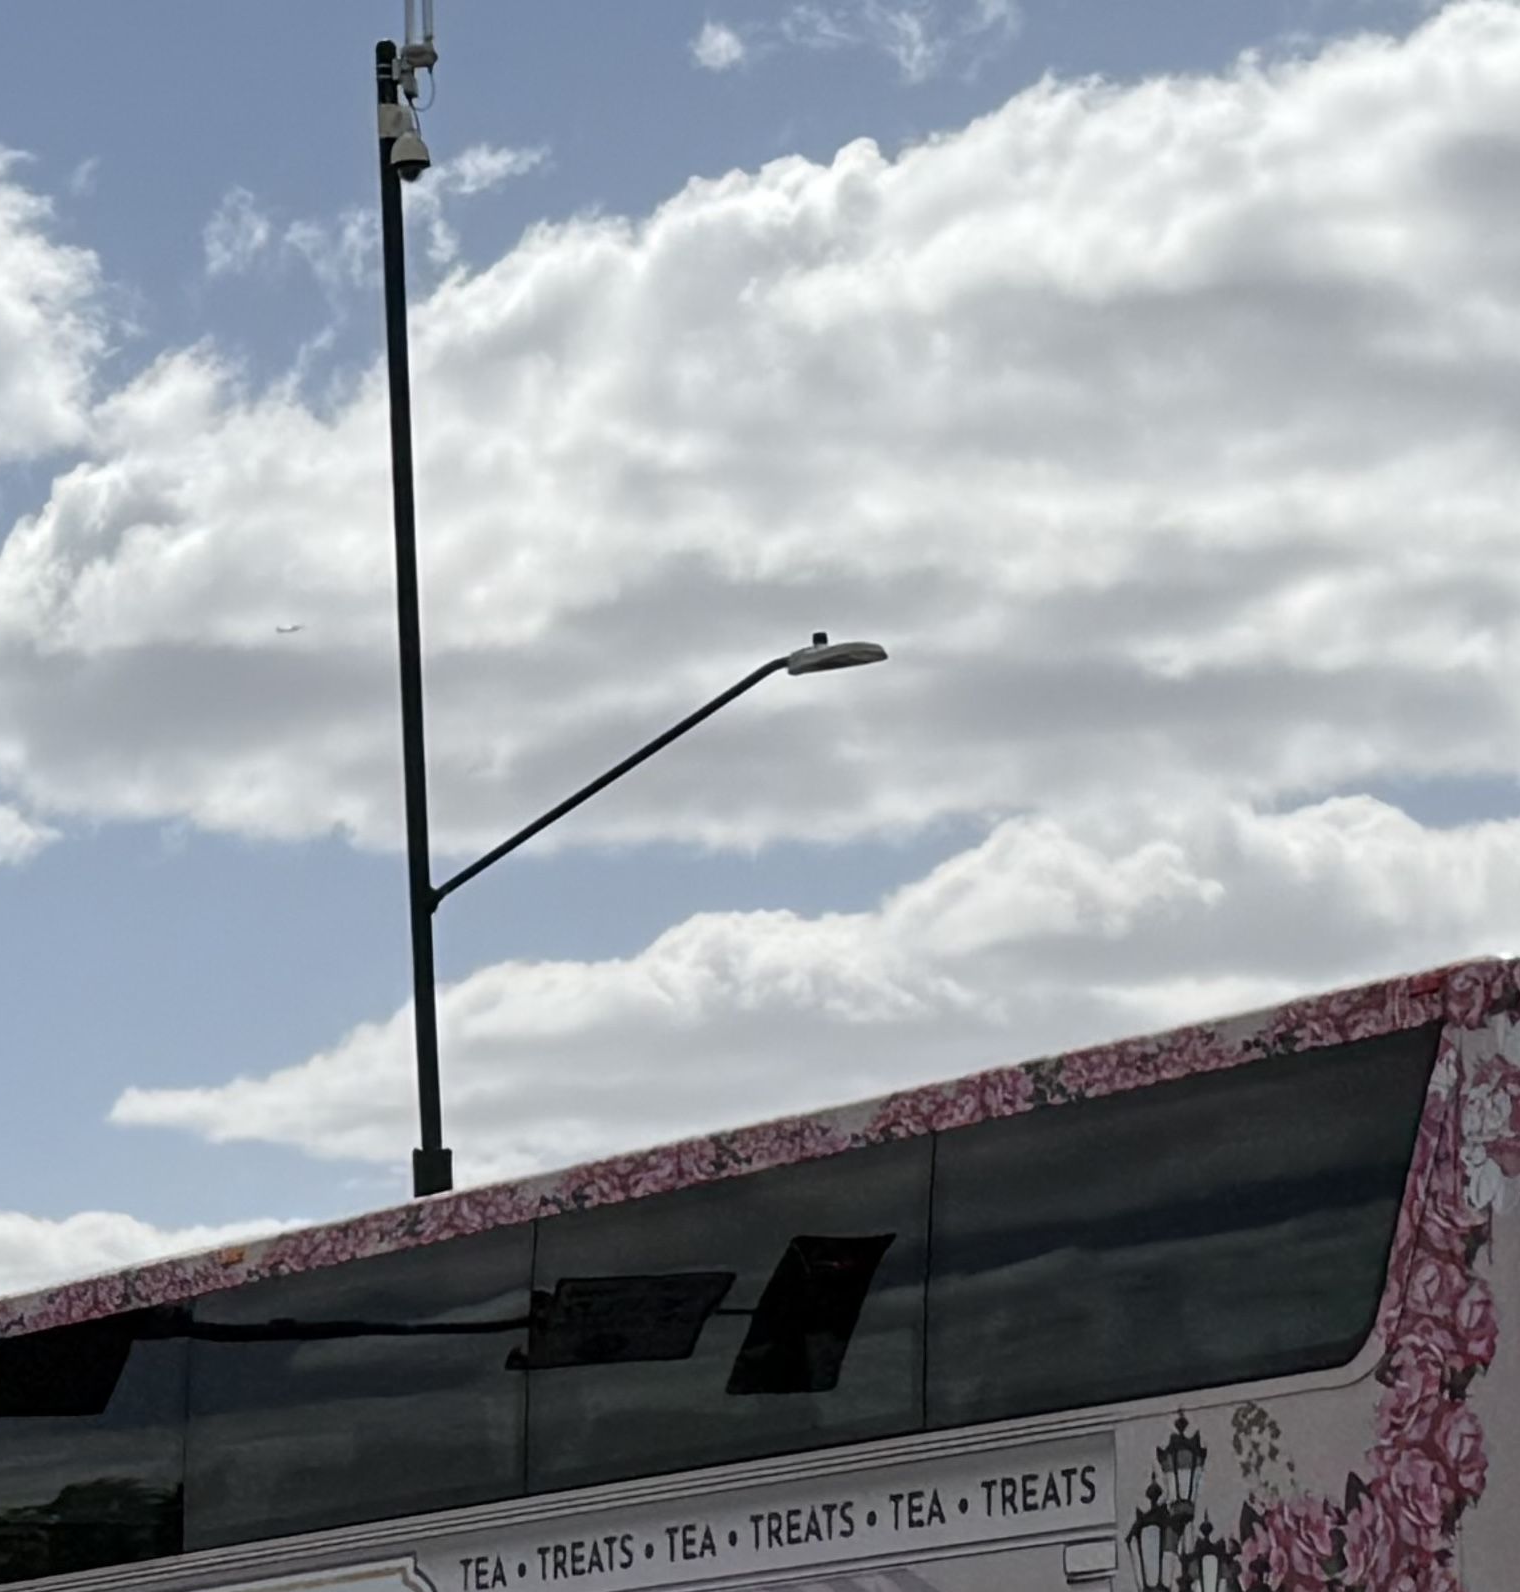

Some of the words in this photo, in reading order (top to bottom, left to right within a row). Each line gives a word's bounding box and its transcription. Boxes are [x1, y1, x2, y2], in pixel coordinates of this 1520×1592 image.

[459, 1554, 508, 1592] TEA
[537, 1533, 634, 1581] TREATS
[665, 1523, 717, 1562] TEA
[749, 1501, 854, 1551] TREATS
[889, 1488, 947, 1531] TEA
[981, 1465, 1097, 1517] TREATS
